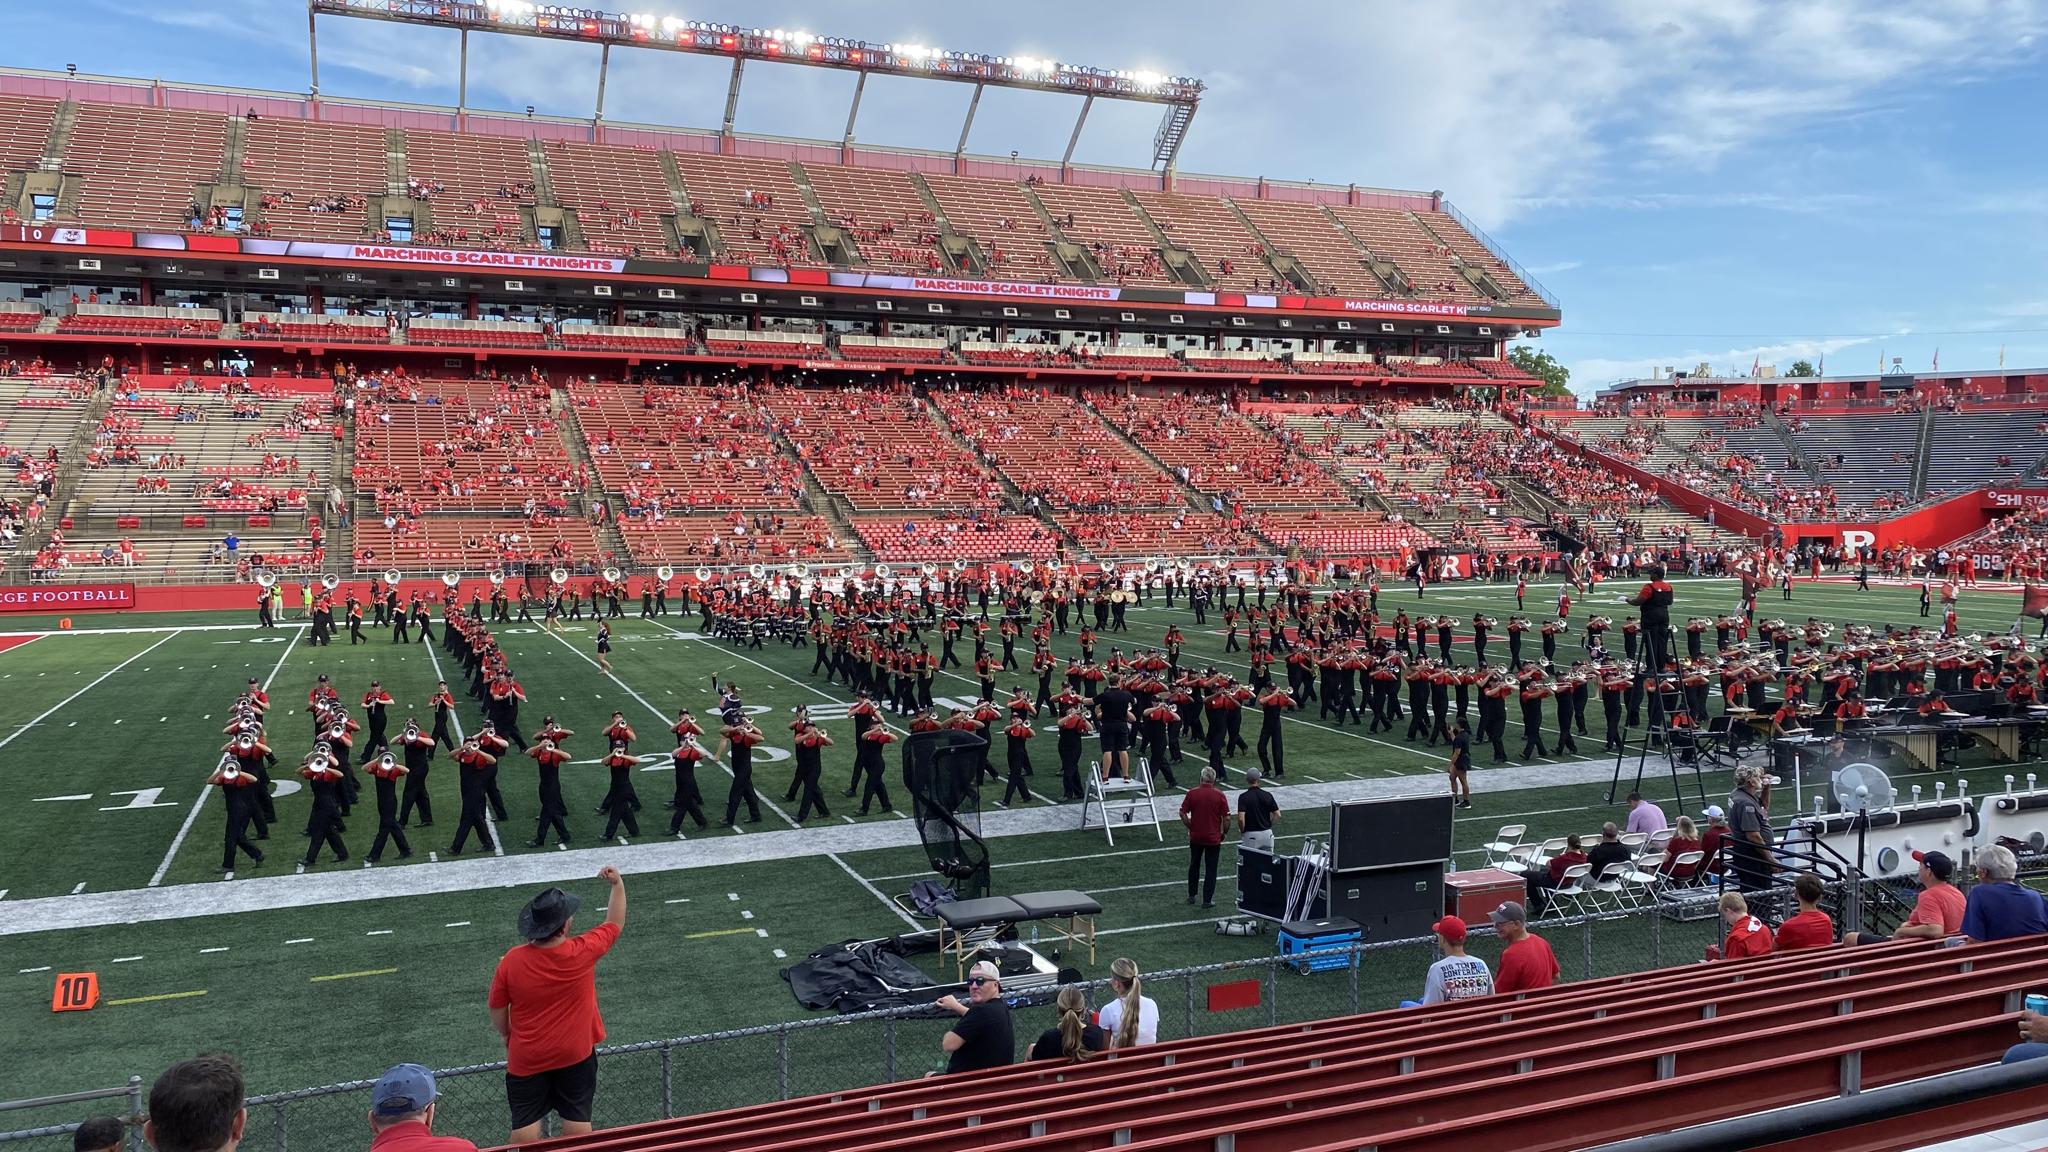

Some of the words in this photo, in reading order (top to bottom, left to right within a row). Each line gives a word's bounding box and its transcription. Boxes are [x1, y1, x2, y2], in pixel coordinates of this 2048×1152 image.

[33, 229, 42, 239] 0
[355, 247, 453, 262] MARCHING
[456, 253, 535, 266] SCARLET
[538, 257, 613, 270] KNIGHTS
[915, 279, 988, 292] MARCHING
[992, 284, 1052, 295] SCARLET
[1054, 286, 1110, 298] KNIGHTS
[1345, 301, 1405, 312] MARCHING
[1407, 303, 1455, 314] SCARLET
[1996, 494, 2022, 506] SHI
[1842, 530, 1876, 559] R
[32, 590, 129, 602] FOOTBALL
[1441, 964, 1454, 972] BIG
[1444, 968, 1487, 978] CONFERENCE
[61, 976, 90, 1007] 10
